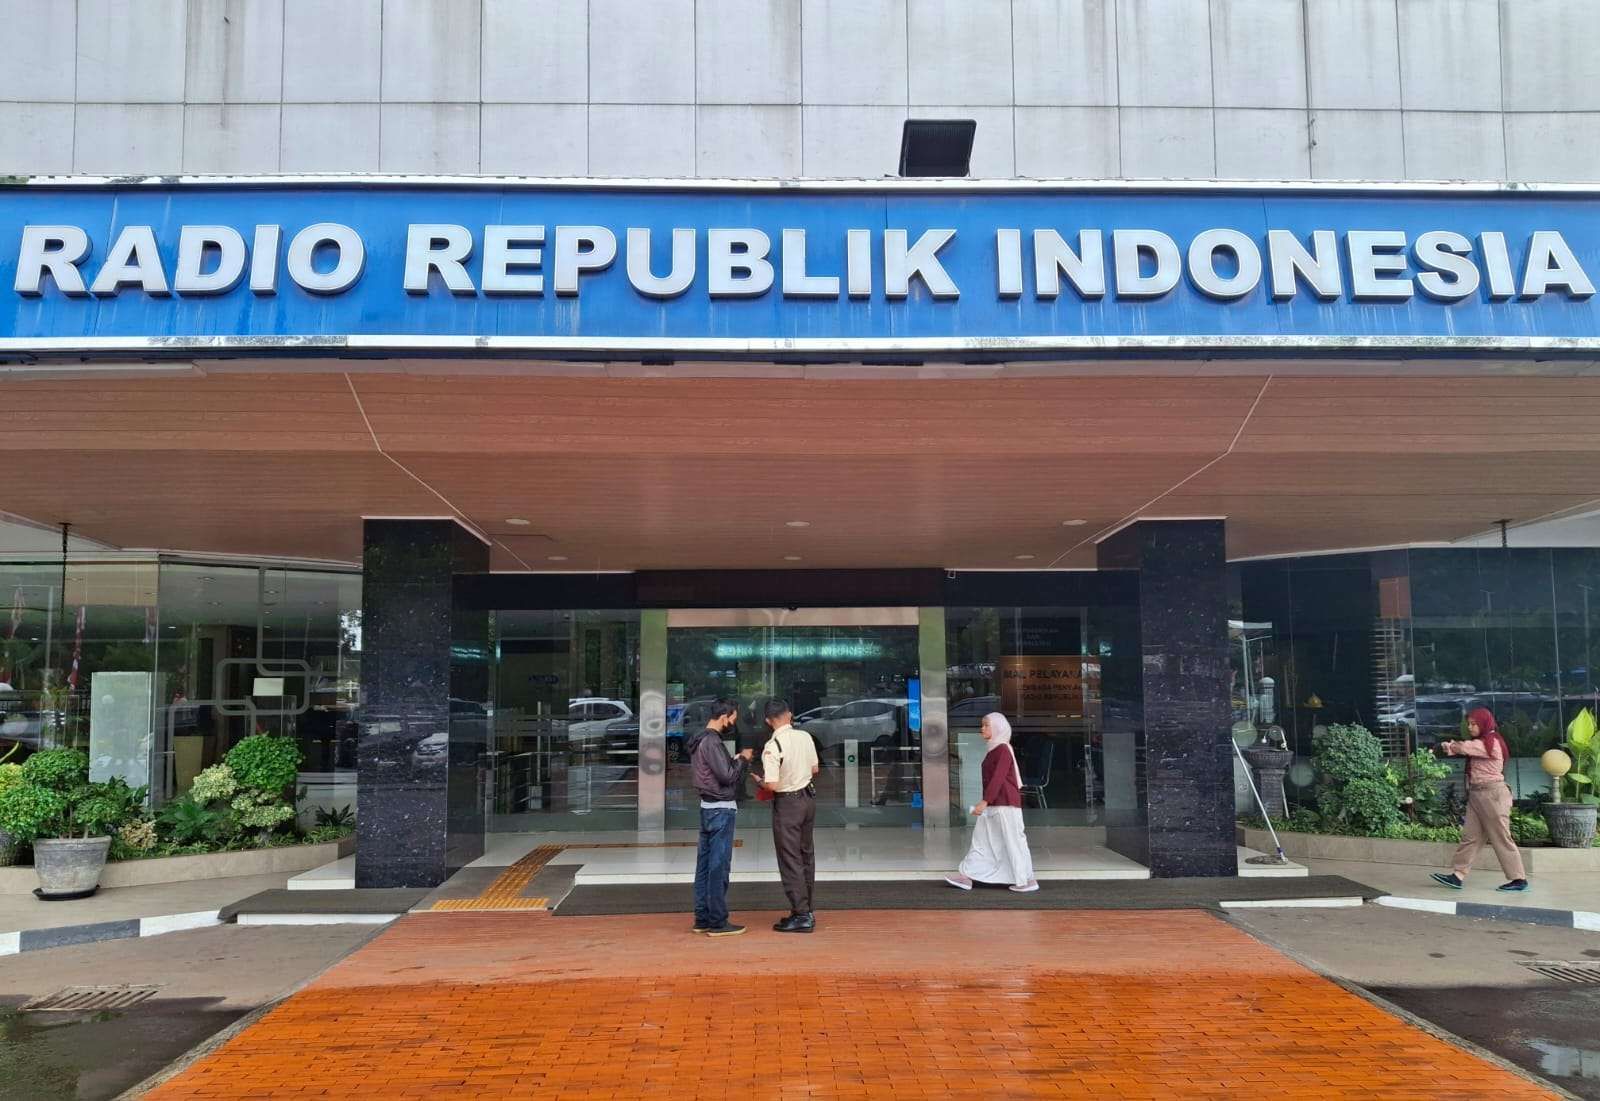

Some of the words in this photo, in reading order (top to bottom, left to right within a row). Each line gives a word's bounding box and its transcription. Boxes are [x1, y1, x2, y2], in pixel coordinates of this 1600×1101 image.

[14, 223, 366, 296] RADIO
[403, 224, 960, 300] REPUBLIK
[997, 228, 1596, 301] INDONESIA
